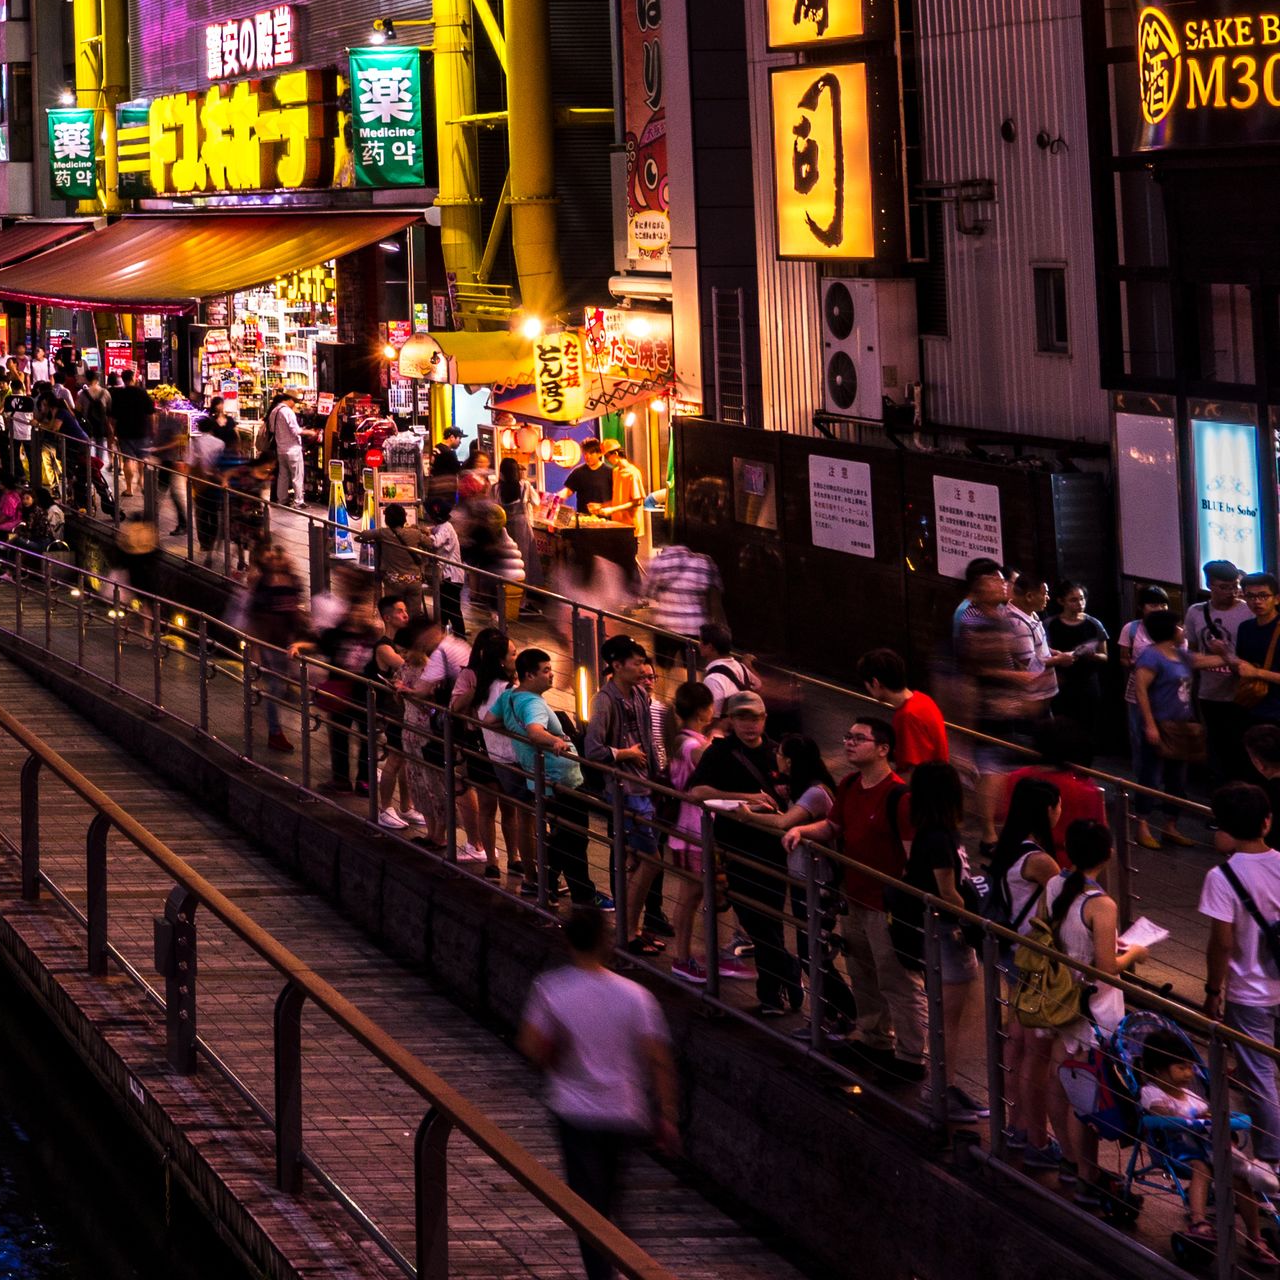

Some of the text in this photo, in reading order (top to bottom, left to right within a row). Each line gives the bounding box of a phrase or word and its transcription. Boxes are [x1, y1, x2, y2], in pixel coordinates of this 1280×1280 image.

[1185, 17, 1255, 51] SAKE
[357, 66, 414, 123] 薬
[53, 122, 91, 159] 薬
[359, 127, 416, 139] Medicine
[53, 161, 92, 170] Medicine
[108, 356, 127, 367] Tax
[609, 337, 671, 372] たこ焼き
[1201, 498, 1225, 513] BLUE
